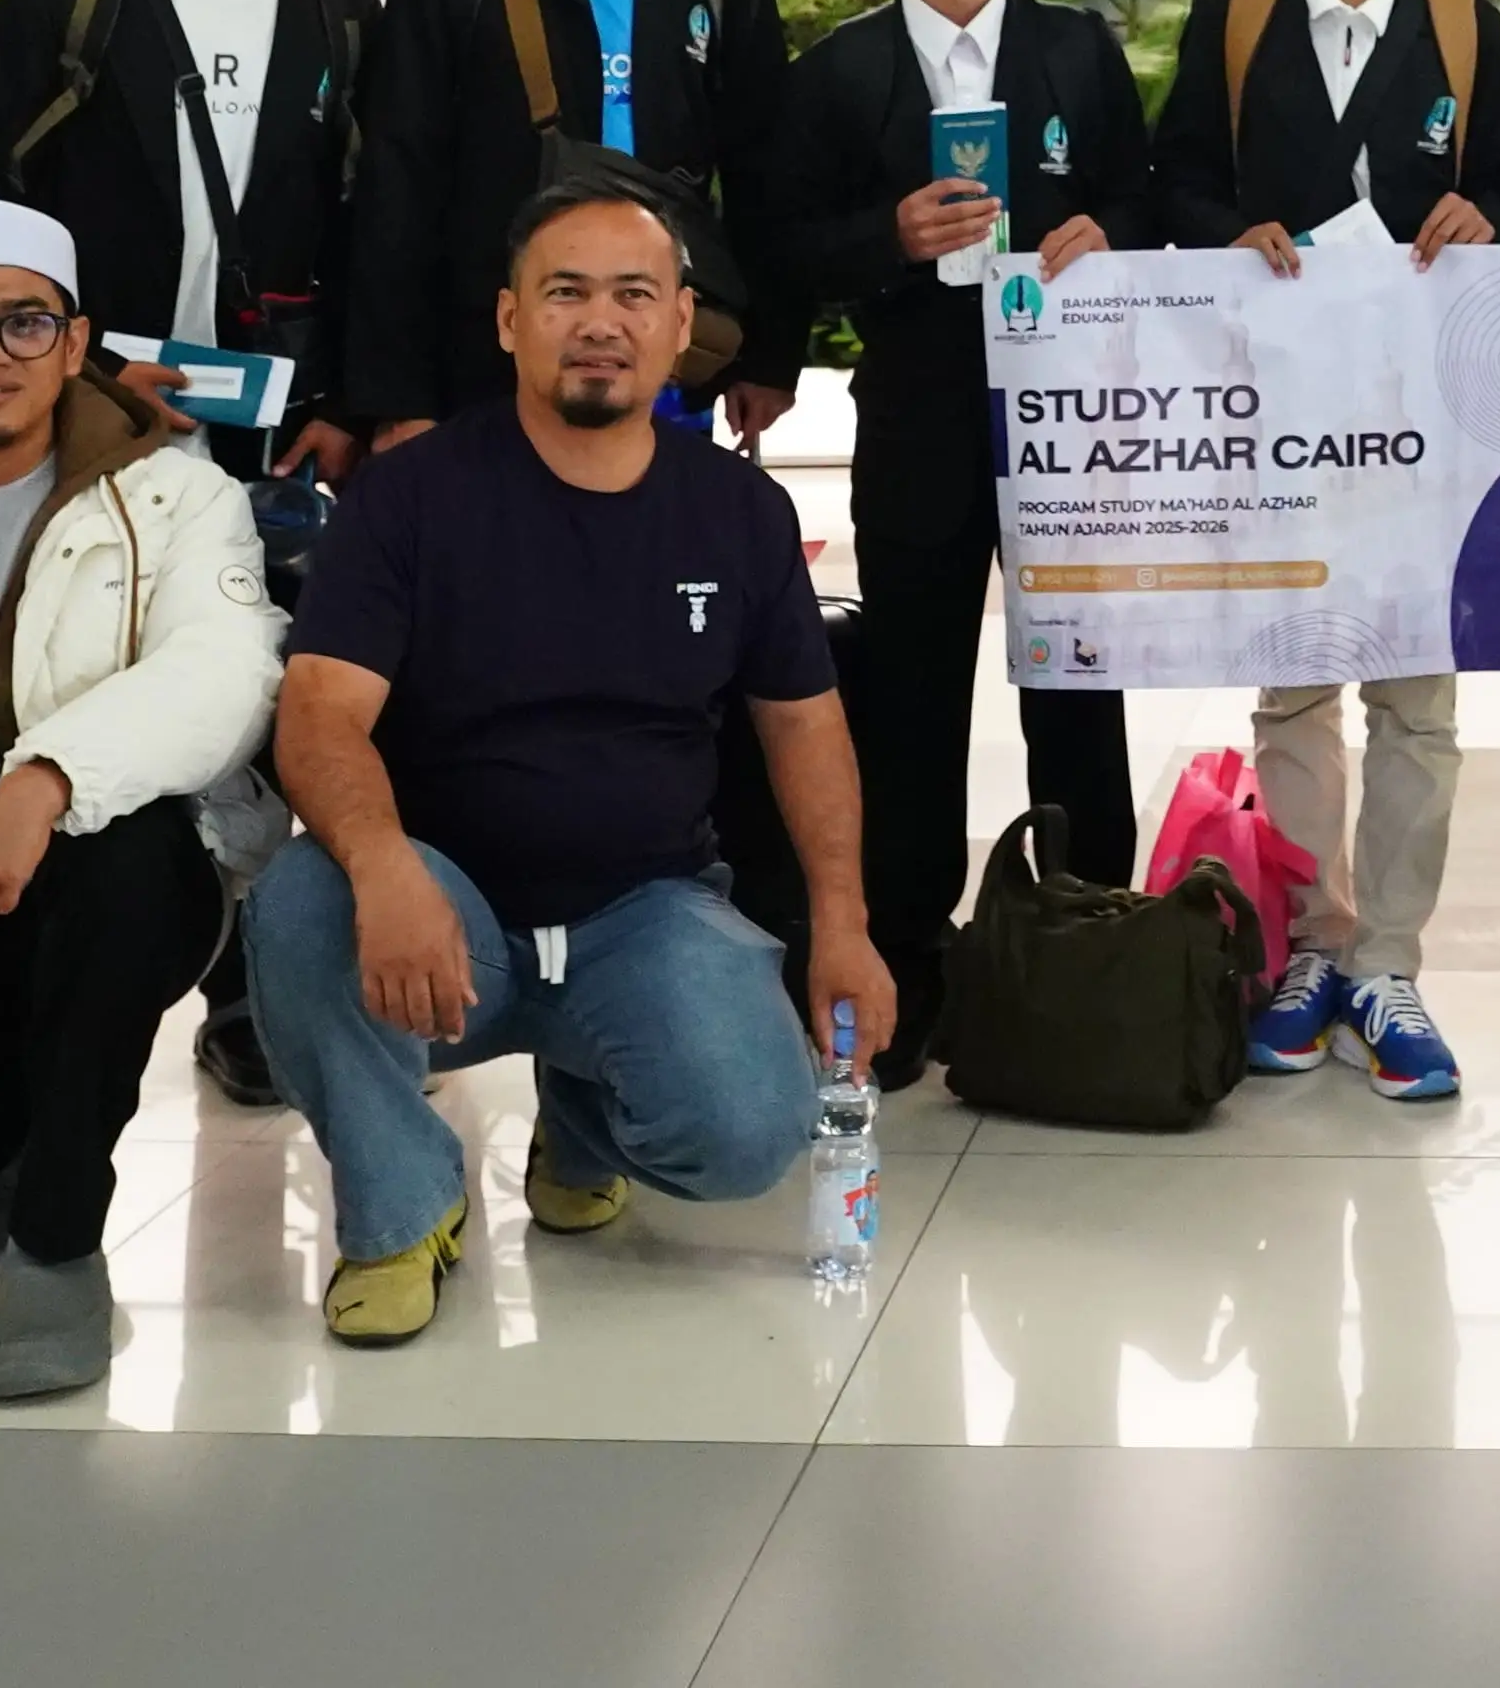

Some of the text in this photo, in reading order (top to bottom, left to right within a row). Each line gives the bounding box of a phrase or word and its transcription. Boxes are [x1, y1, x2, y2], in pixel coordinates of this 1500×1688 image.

[1061, 295, 1215, 310] BAHARSYAH JELAJAH
[1061, 313, 1124, 324] EDUKASI
[1017, 384, 1260, 424] STUDY TO
[1018, 430, 1426, 474] AL AZHAR CAIRO
[1018, 501, 1096, 514] PROGRAM
[1100, 500, 1156, 513] STUDY
[1232, 497, 1255, 510] AL
[1258, 496, 1318, 510] AZHAR
[1018, 520, 1230, 535] TAHUN AJARAN 2025-2026
